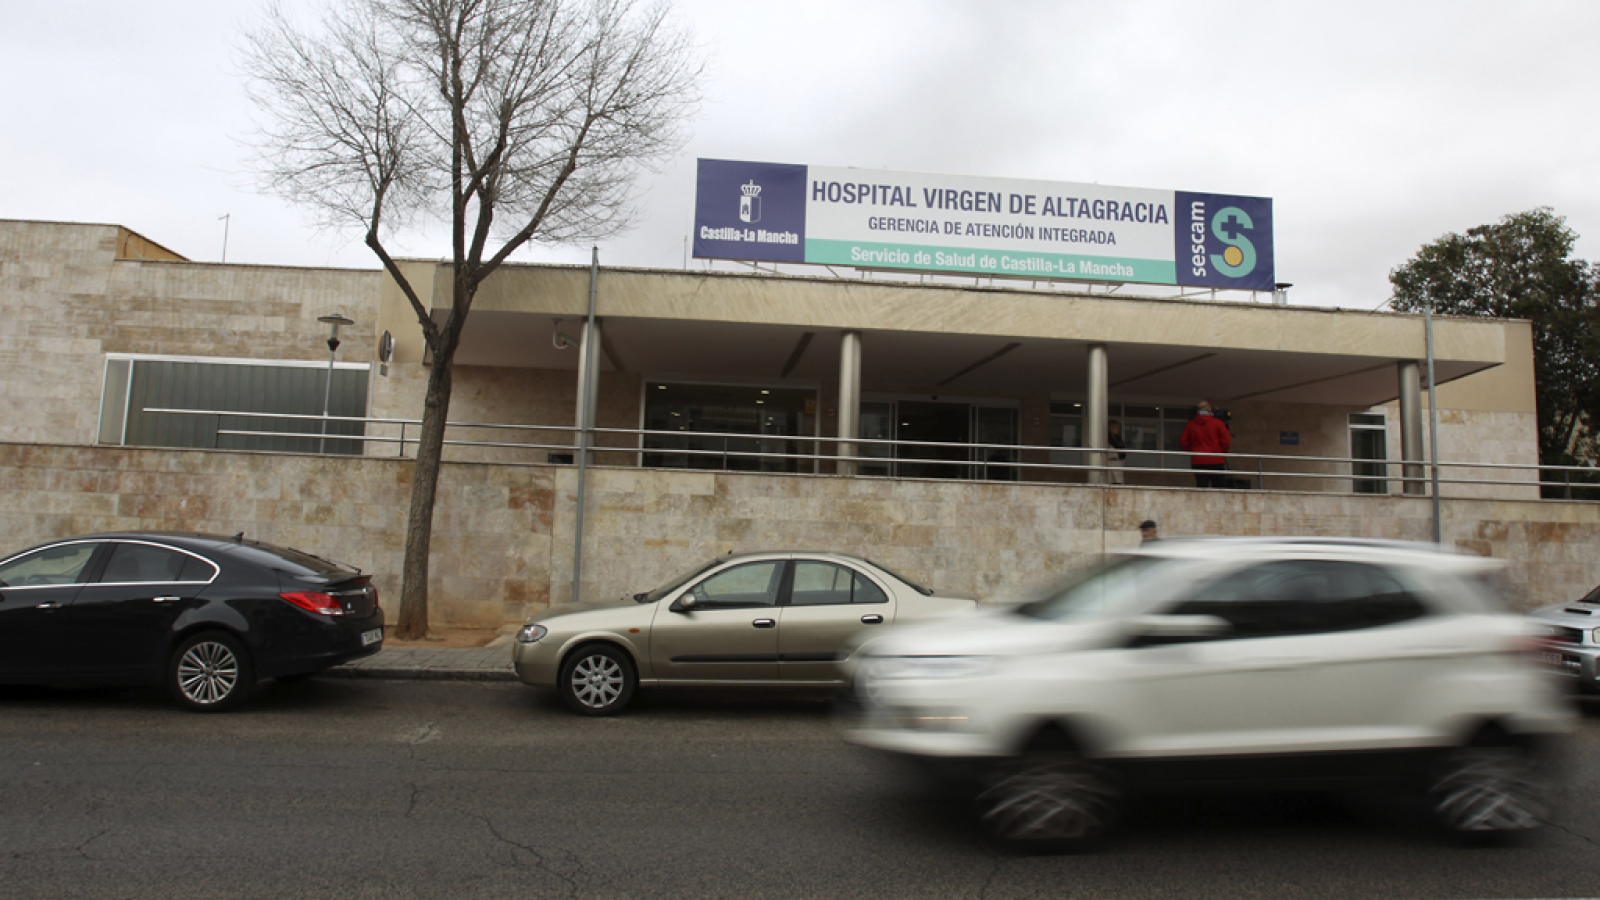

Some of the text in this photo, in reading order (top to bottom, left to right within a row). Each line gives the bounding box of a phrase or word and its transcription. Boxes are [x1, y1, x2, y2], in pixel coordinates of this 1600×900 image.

[812, 180, 1168, 224] HOSPITAL VIRGEN DE ALTAGRACIA
[700, 226, 798, 244] Castilla-La Mancha
[868, 216, 1116, 245] GERENCIA DE ATENCIÓN INTEGRADA
[1191, 201, 1206, 277] sescam
[851, 246, 1134, 277] Servicio de Salud de Castilla-La Mancha
